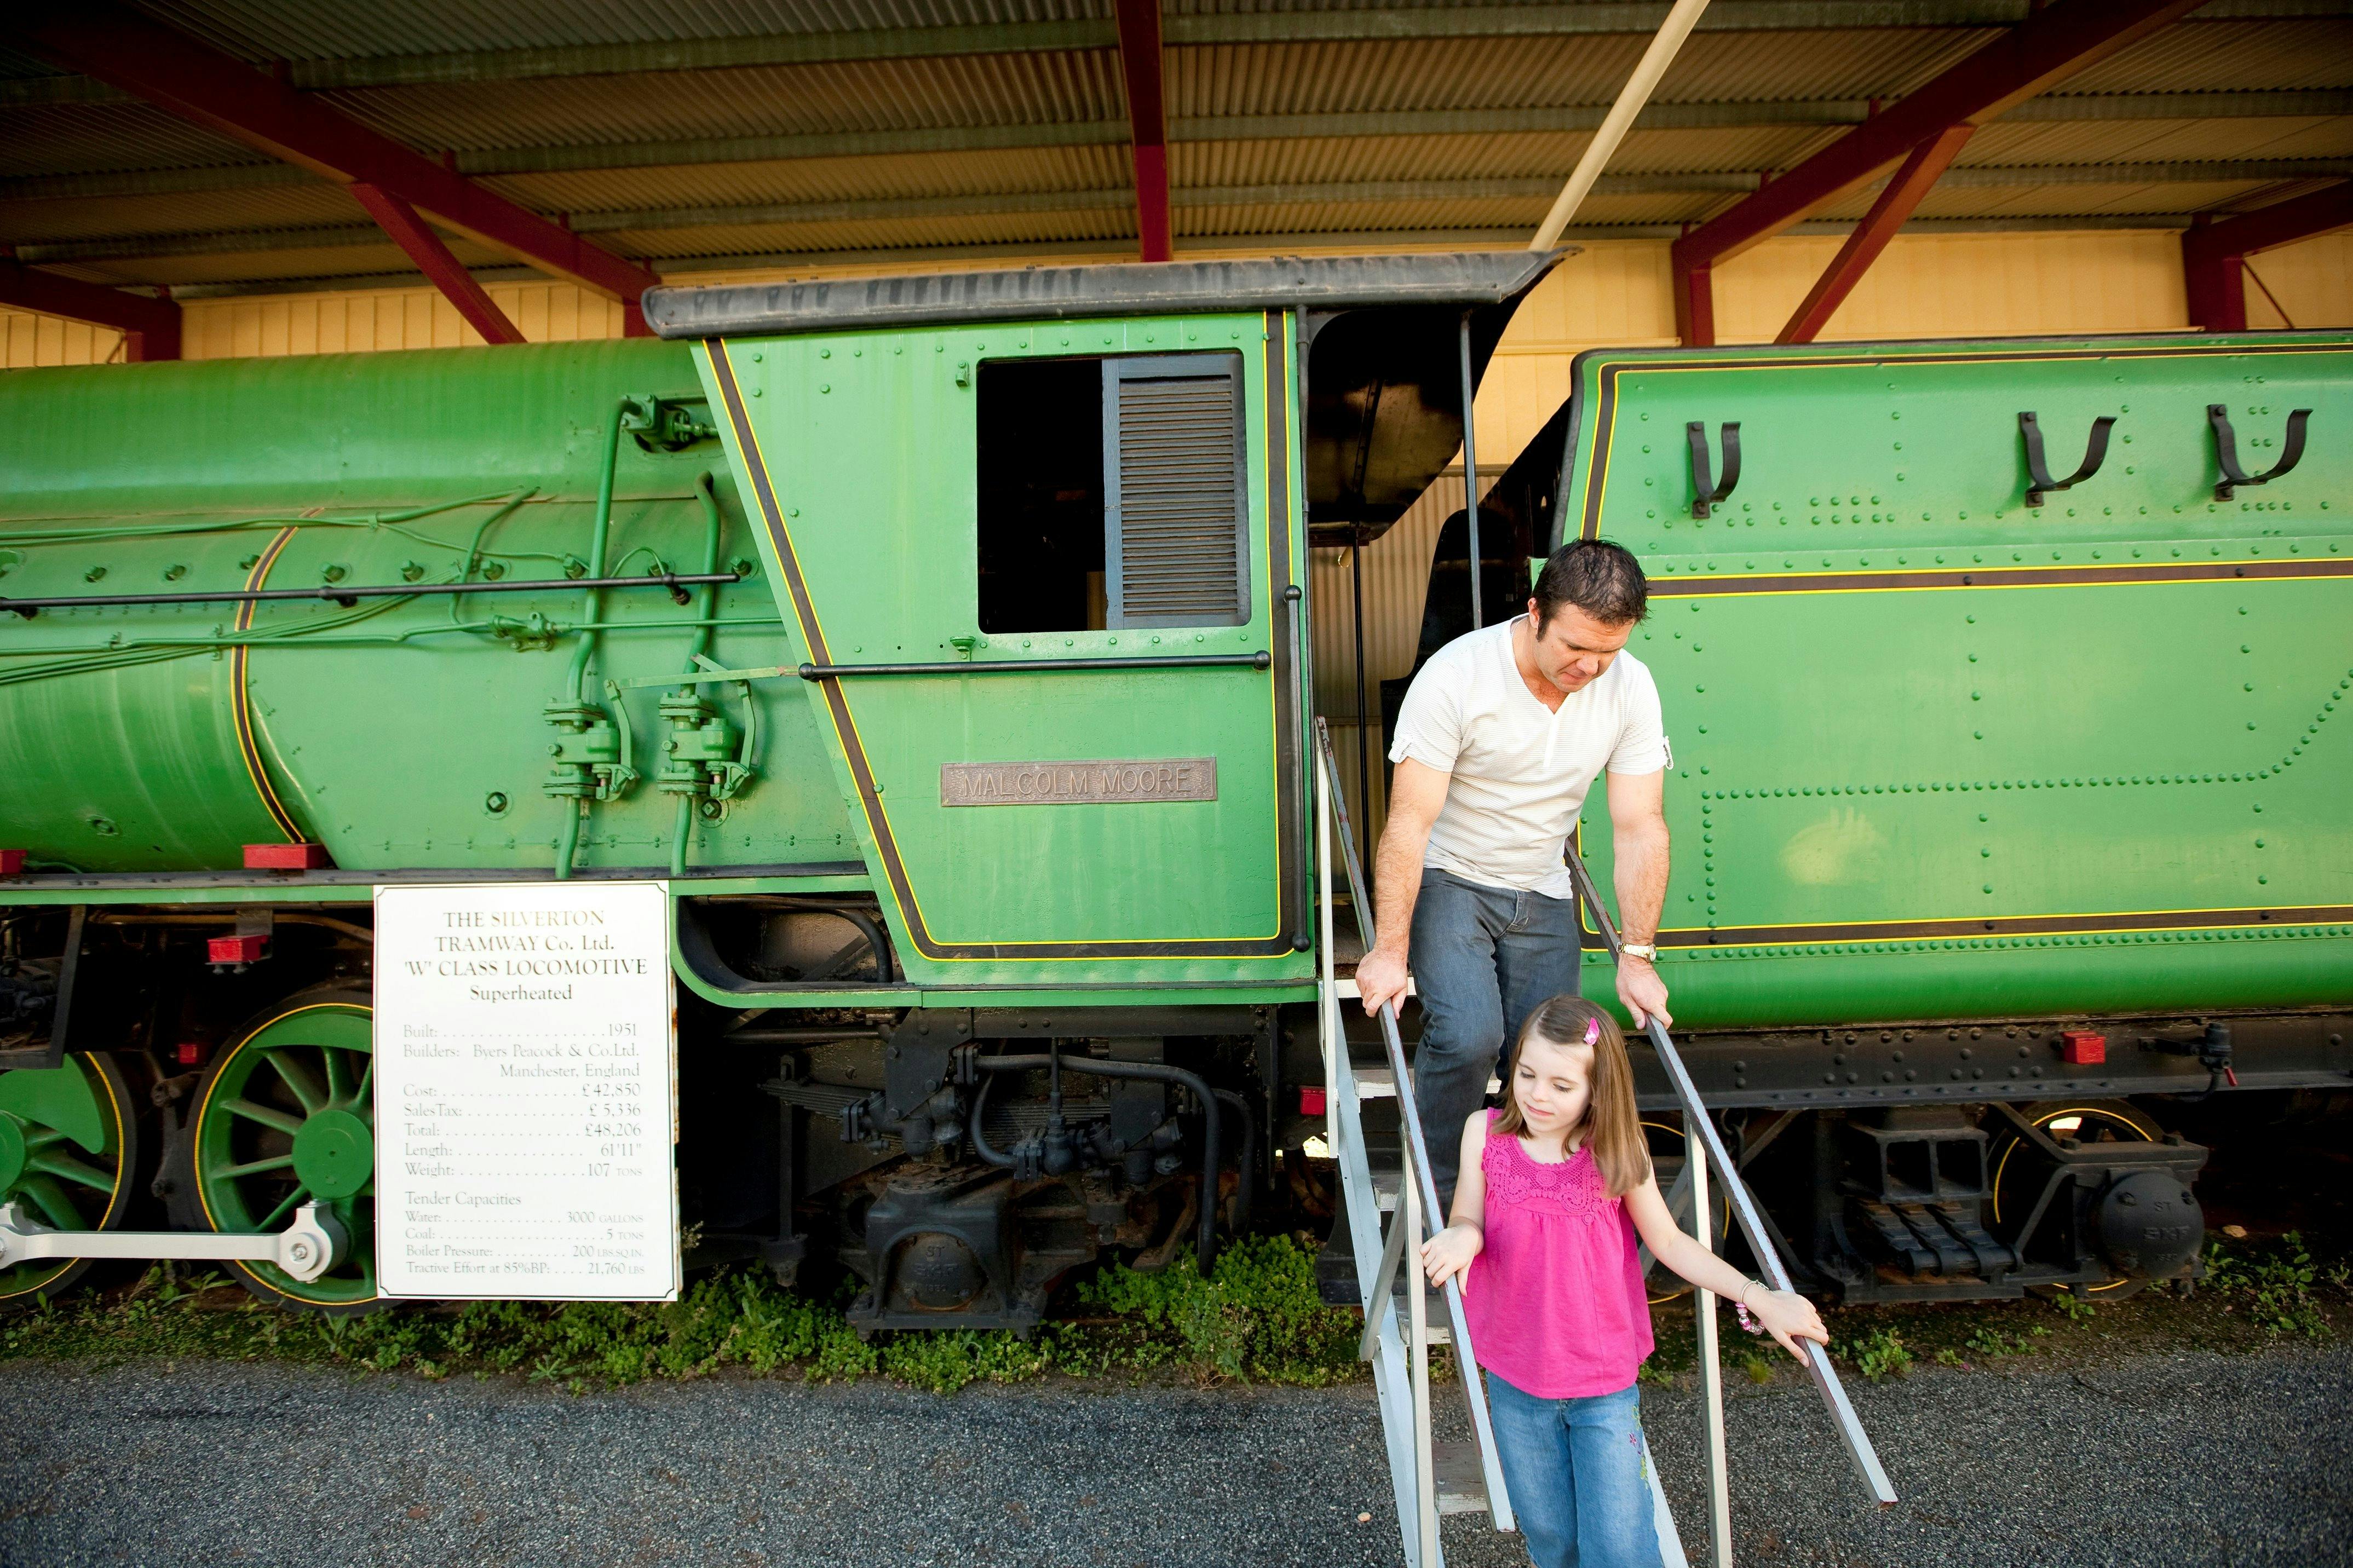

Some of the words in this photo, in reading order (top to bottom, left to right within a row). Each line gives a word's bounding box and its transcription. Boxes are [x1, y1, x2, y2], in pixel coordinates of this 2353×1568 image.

[963, 770, 1089, 797] MALCOLM
[1102, 768, 1192, 794] MOORE
[443, 912, 485, 927] THE
[491, 910, 605, 927] SILVERTON
[434, 936, 538, 952] TRAMWAY
[545, 936, 573, 950] Co.
[582, 935, 614, 950] Ltd.
[438, 960, 498, 976] CLASS
[506, 959, 647, 976] LOCOMOTIVE
[470, 984, 573, 1003] Superheated
[403, 1024, 438, 1038] Built:
[608, 1024, 637, 1036] 1951
[403, 1044, 460, 1057] Builders:
[473, 1044, 507, 1060] Byers
[513, 1044, 562, 1057] Peacock
[568, 1044, 582, 1057] &
[500, 1064, 579, 1078] Manchester,
[585, 1063, 640, 1077] England
[403, 1083, 437, 1097] Cost:
[404, 1123, 440, 1137] Total:
[585, 1123, 641, 1138] £48,206
[404, 1143, 452, 1158] Length:
[405, 1162, 455, 1178] Weight:
[587, 1163, 610, 1177] 107
[615, 1168, 643, 1176] TONS
[405, 1191, 451, 1204] Tender
[455, 1191, 521, 1208] Capacities
[405, 1210, 441, 1223] Water:
[567, 1211, 595, 1223] 3000
[599, 1214, 643, 1223] GALLONS
[405, 1227, 435, 1240] Coal:
[607, 1229, 613, 1240] 5
[618, 1231, 644, 1240] TONS
[406, 1245, 440, 1256] Boiler
[444, 1245, 493, 1256] Pressure:
[573, 1246, 594, 1257] 200
[925, 1245, 945, 1257] ST
[406, 1262, 449, 1273] Tractive
[453, 1262, 485, 1273] Effort
[490, 1264, 499, 1273] at
[629, 1265, 645, 1274] LBS
